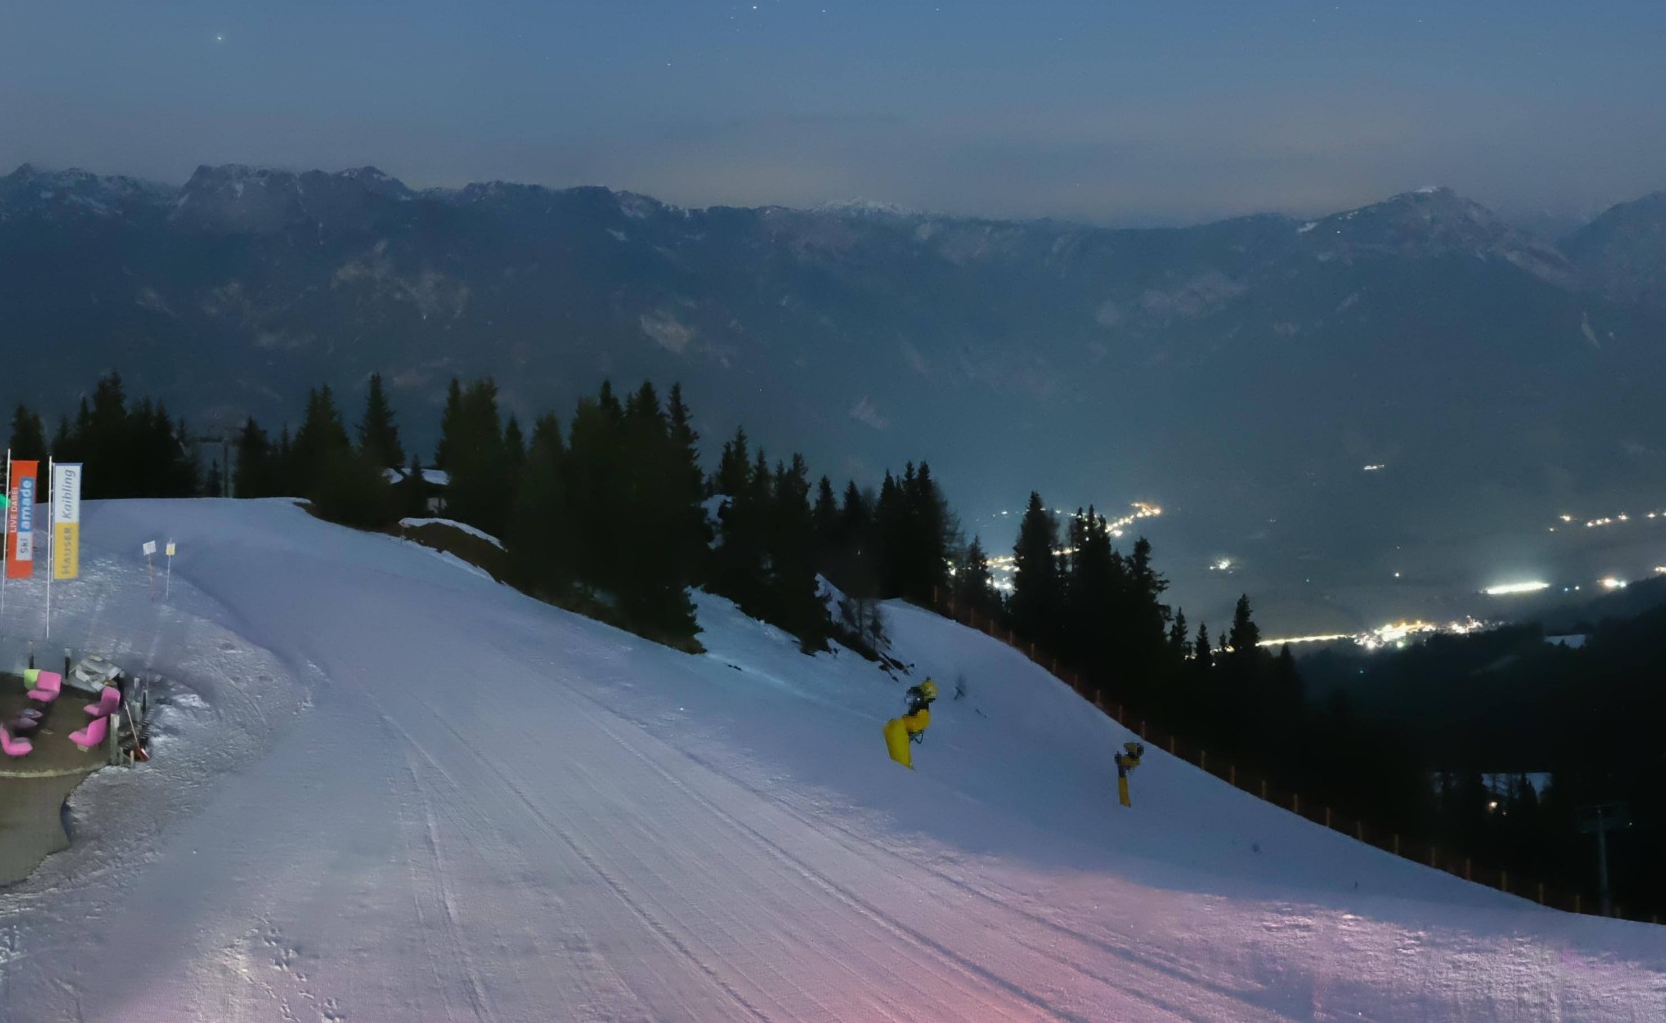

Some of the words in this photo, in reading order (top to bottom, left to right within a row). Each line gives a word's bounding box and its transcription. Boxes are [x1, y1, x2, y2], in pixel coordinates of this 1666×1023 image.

[10, 486, 18, 512] DABEI
[62, 469, 76, 519] Kaibling
[9, 514, 17, 533] LIVE
[61, 527, 72, 575] HAUSER
